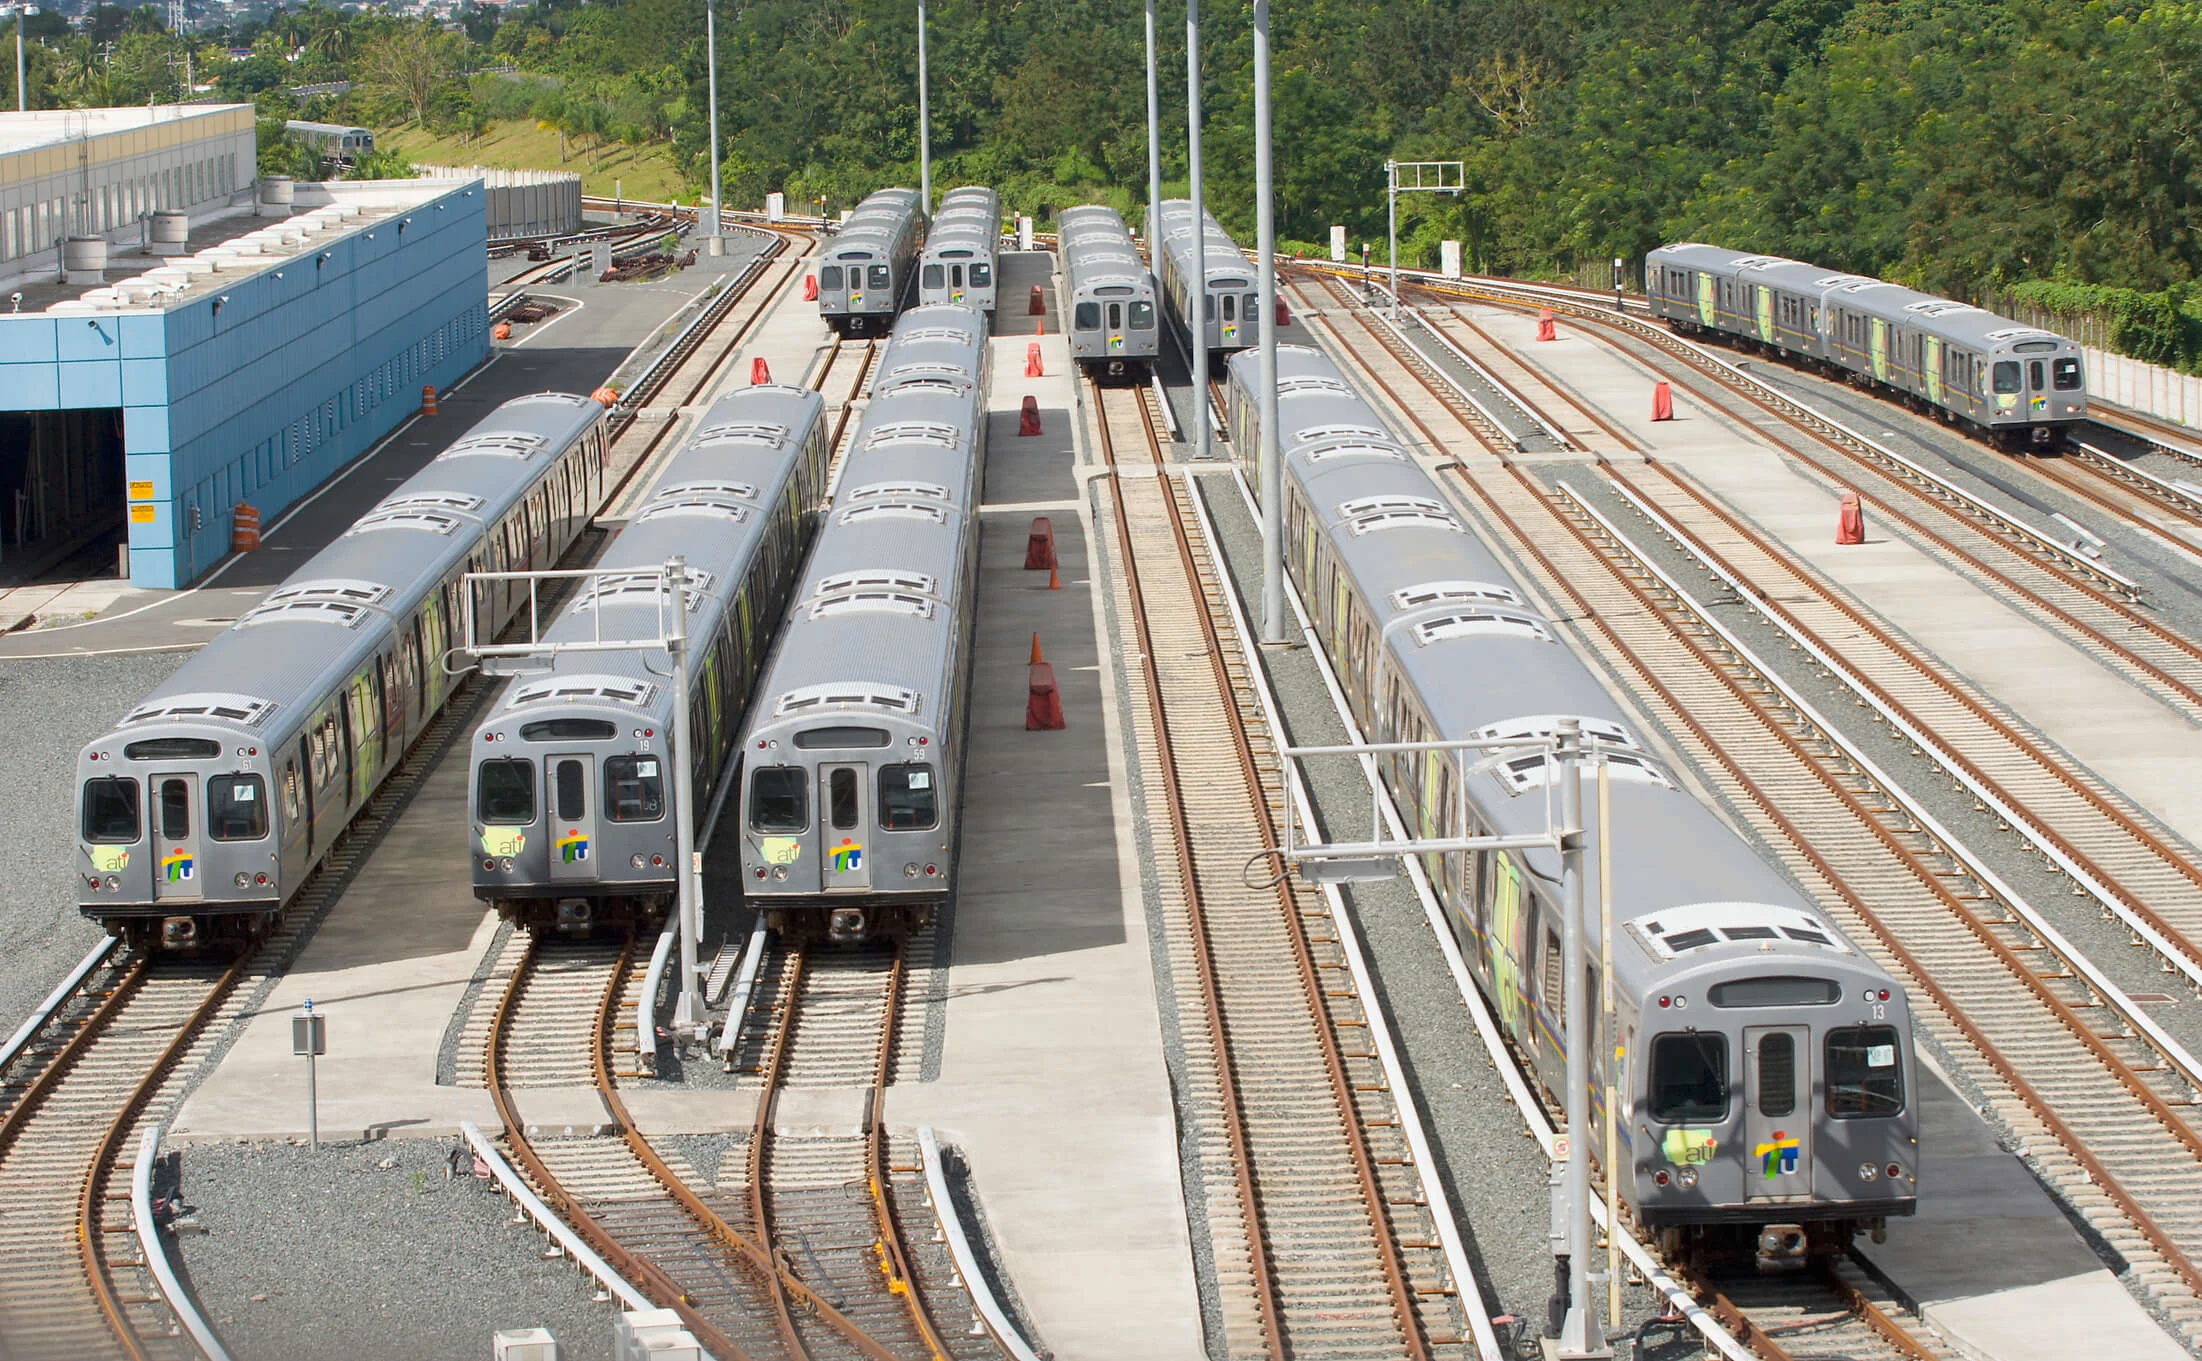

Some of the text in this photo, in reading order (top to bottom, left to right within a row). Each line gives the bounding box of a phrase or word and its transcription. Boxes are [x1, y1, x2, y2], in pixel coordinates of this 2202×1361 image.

[640, 739, 649, 752] 19
[913, 749, 925, 760] 59
[241, 759, 252, 770] 61
[499, 834, 524, 854] ati
[776, 843, 800, 862] ati
[106, 852, 128, 870] ati
[1872, 1004, 1885, 1020] 13
[1685, 1138, 1714, 1163] ati
